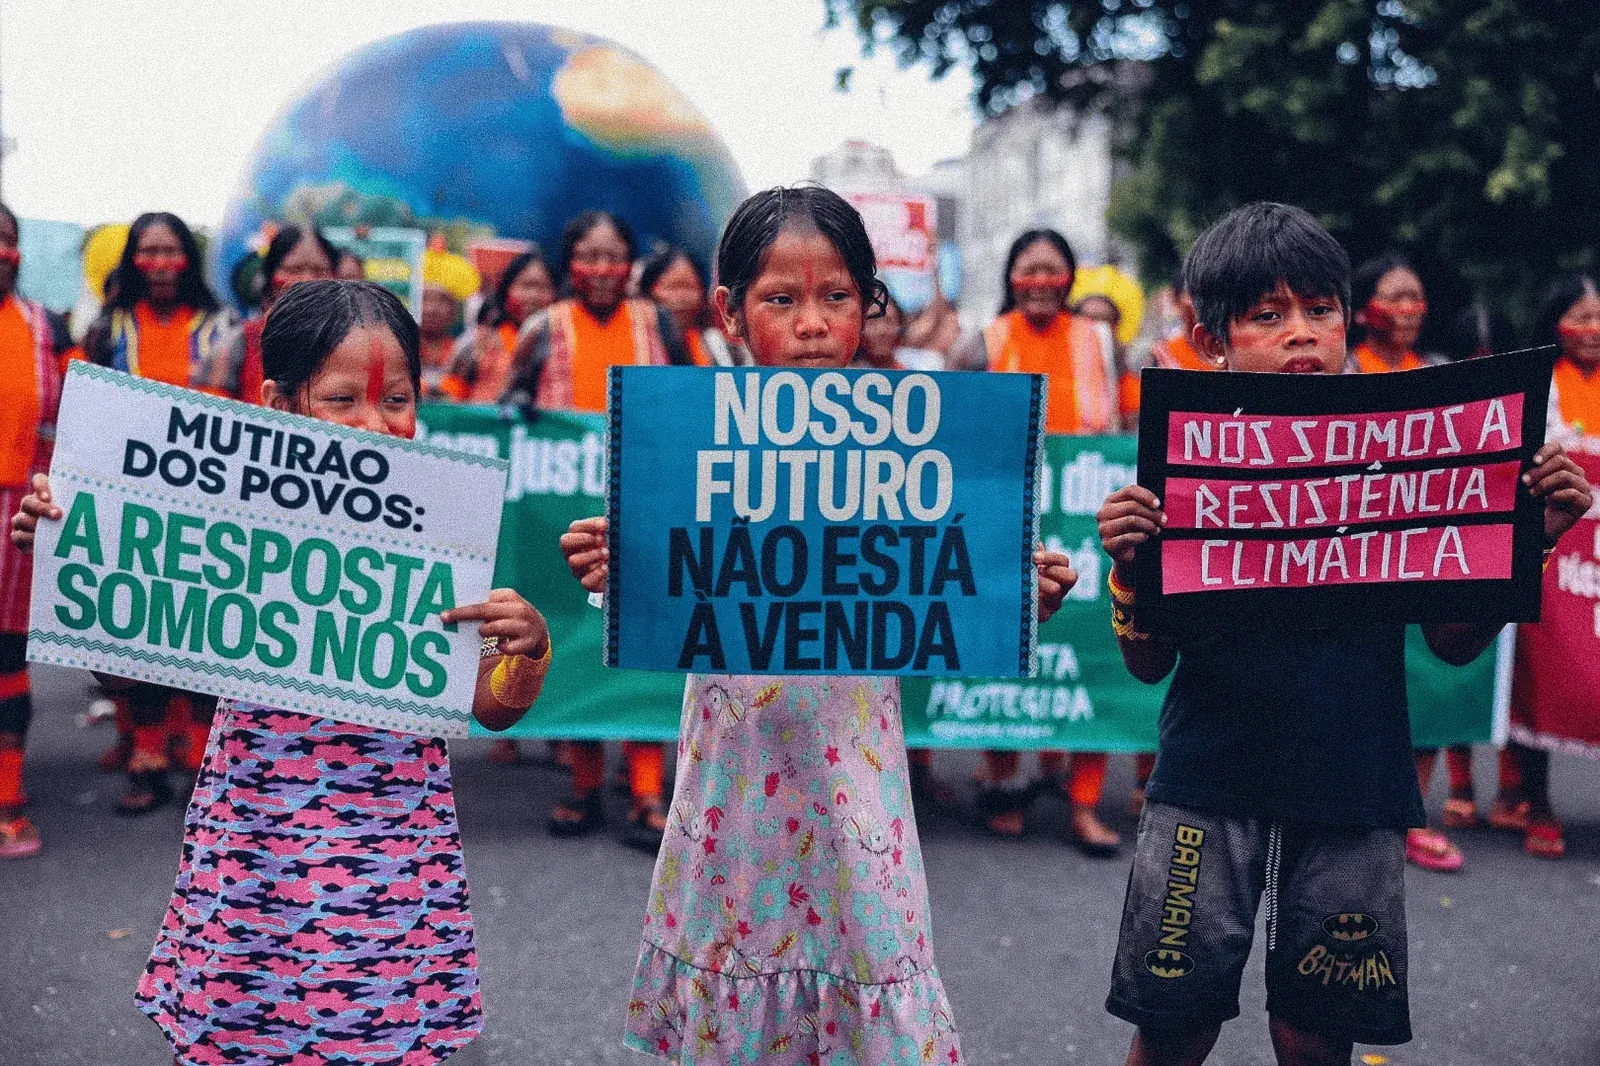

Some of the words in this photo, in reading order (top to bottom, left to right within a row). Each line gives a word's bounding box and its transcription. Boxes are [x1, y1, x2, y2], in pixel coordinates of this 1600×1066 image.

[713, 371, 941, 447] NOSSO
[1183, 406, 1275, 466] NÓS
[1286, 405, 1465, 464] SOMOS
[1477, 397, 1511, 450] A
[122, 439, 227, 496] DOS
[239, 464, 426, 533] POVOS:
[695, 450, 954, 522] FUTURO
[1195, 459, 1489, 529] RESISTÊNCIA
[53, 491, 105, 568] A
[116, 500, 459, 633] RESPOSTA
[667, 515, 809, 598] NÃO
[820, 513, 978, 598] ESTÁ
[1201, 525, 1471, 586] CLIMÁTICA
[53, 562, 300, 669] SOMOS
[676, 588, 728, 671] À
[738, 601, 961, 671] VENDA
[1159, 824, 1205, 947] BATMAN
[1297, 944, 1396, 991] BATMAN
